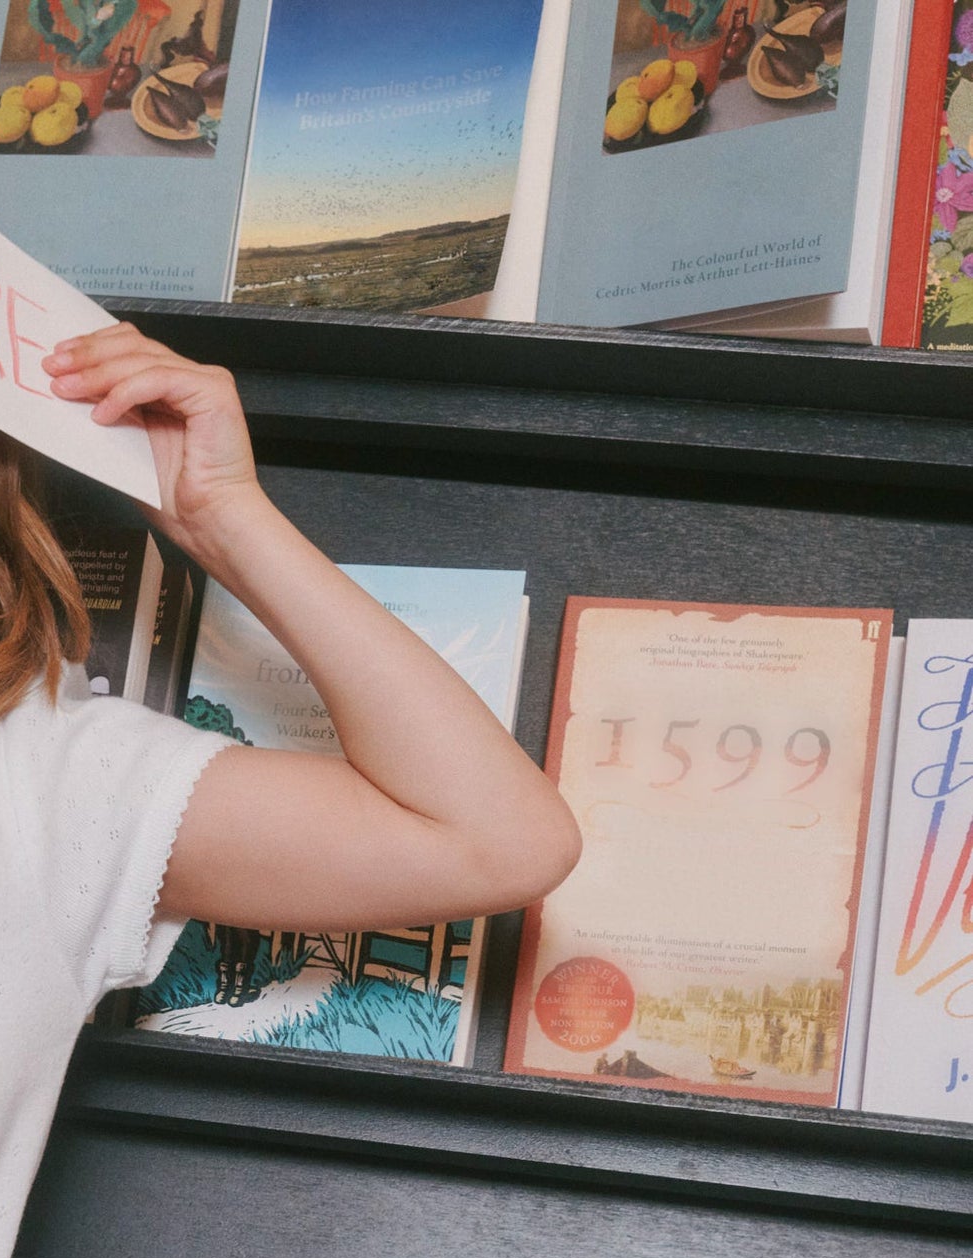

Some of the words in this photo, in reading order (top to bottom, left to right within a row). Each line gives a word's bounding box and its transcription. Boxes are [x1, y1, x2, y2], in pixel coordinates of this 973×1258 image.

[295, 92, 337, 108] How
[342, 80, 417, 101] Farming
[423, 74, 456, 90] Can
[462, 65, 503, 83] Save
[380, 88, 491, 119] Countryside
[671, 259, 693, 272] The
[696, 245, 759, 267] Colourful
[763, 238, 805, 254] World
[808, 234, 822, 249] of
[72, 263, 134, 276] Colourful
[138, 266, 179, 277] World
[182, 267, 195, 278] of
[596, 286, 636, 300] Cedric
[640, 277, 680, 294] Morris
[683, 273, 696, 285] &
[697, 266, 739, 283] Arthur
[743, 254, 821, 275] Lett-Haines
[74, 279, 116, 290] Arthur
[119, 279, 194, 292] Lett-Haines
[99, 550, 116, 558] feat
[115, 562, 126, 573] by
[273, 703, 307, 717] Four
[595, 717, 831, 794] 1599
[553, 963, 619, 988] WINNER
